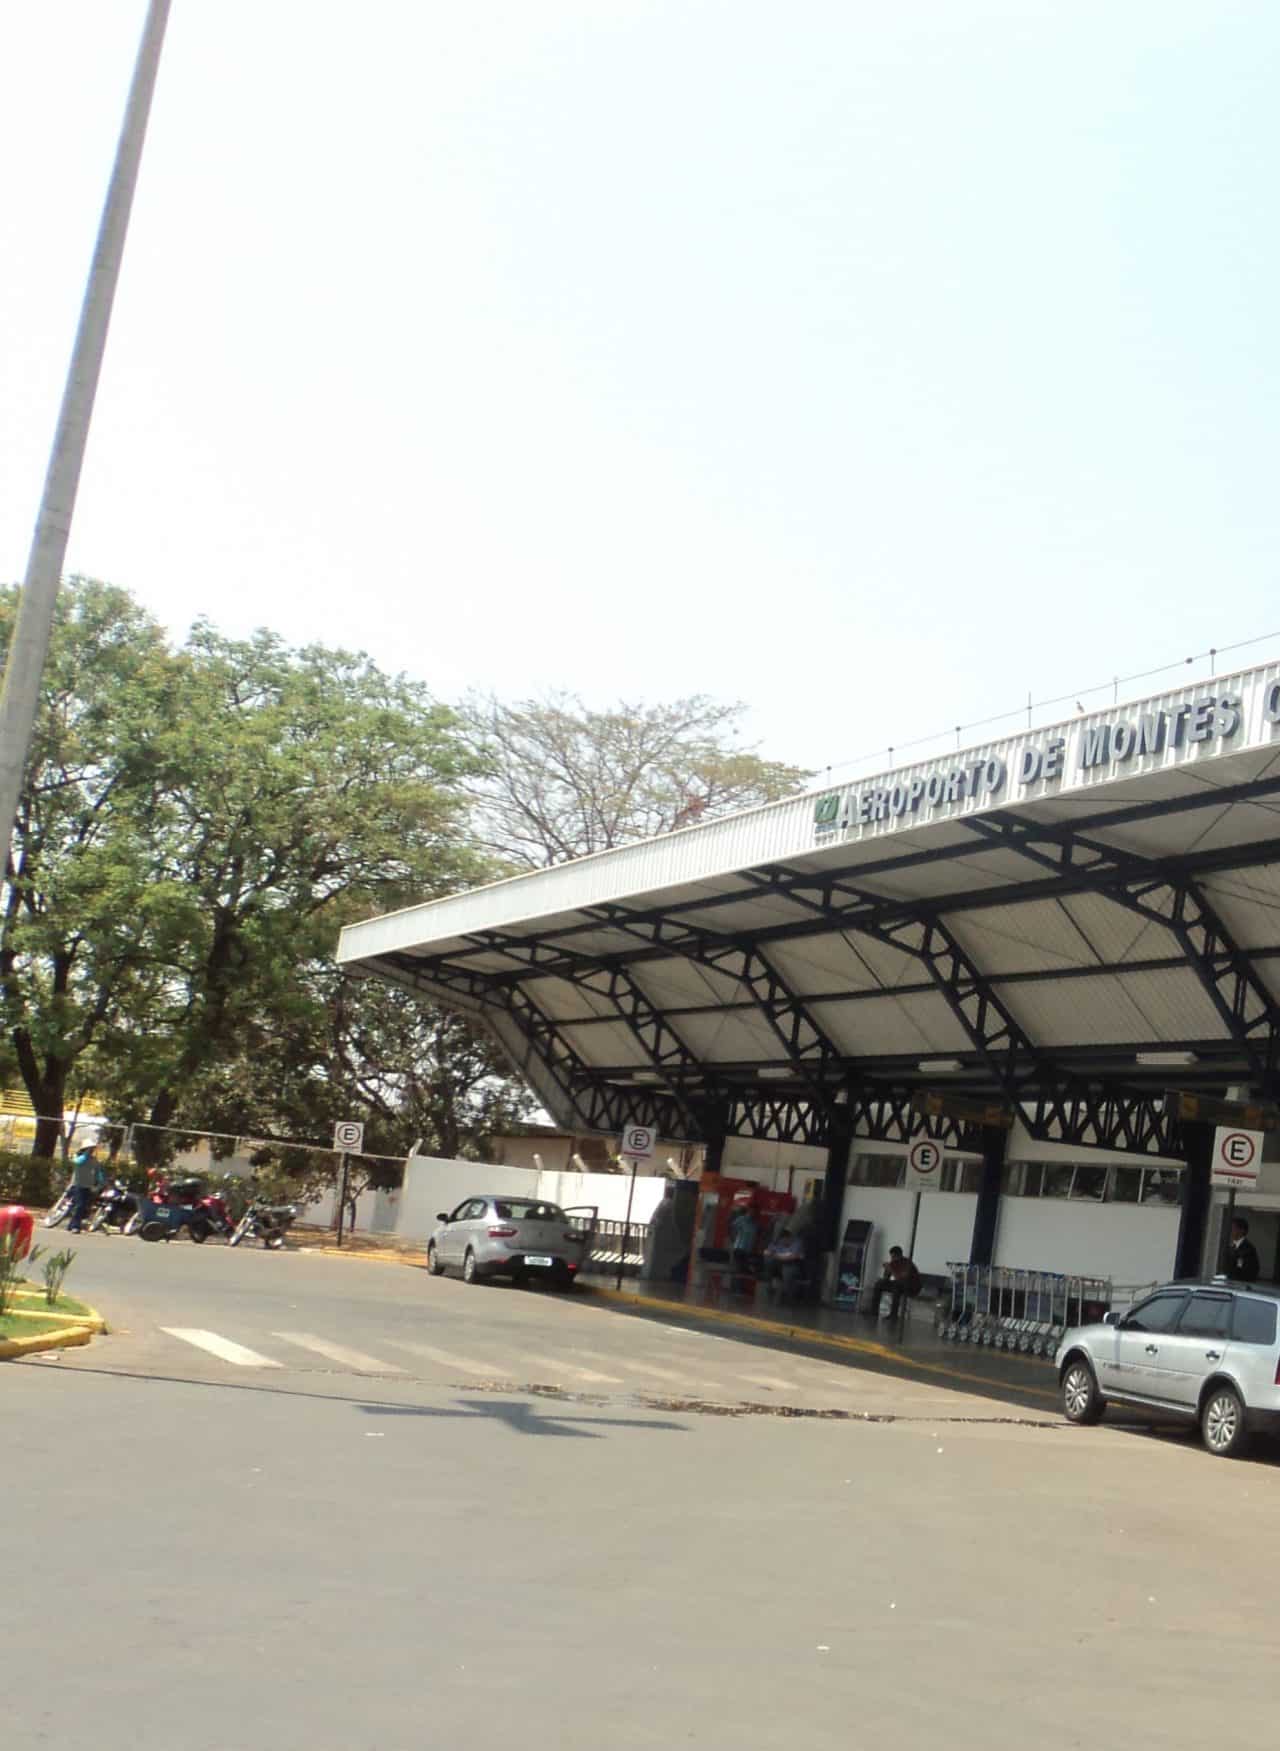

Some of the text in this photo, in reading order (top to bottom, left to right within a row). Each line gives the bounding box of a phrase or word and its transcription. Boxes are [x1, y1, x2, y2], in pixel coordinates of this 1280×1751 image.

[835, 753, 1007, 829] AEROPORTO
[1018, 738, 1065, 784] DE
[1080, 693, 1242, 769] MONTES
[344, 1128, 355, 1140] E
[635, 1134, 645, 1146] E
[921, 1149, 931, 1164] E
[1231, 1140, 1247, 1160] E
